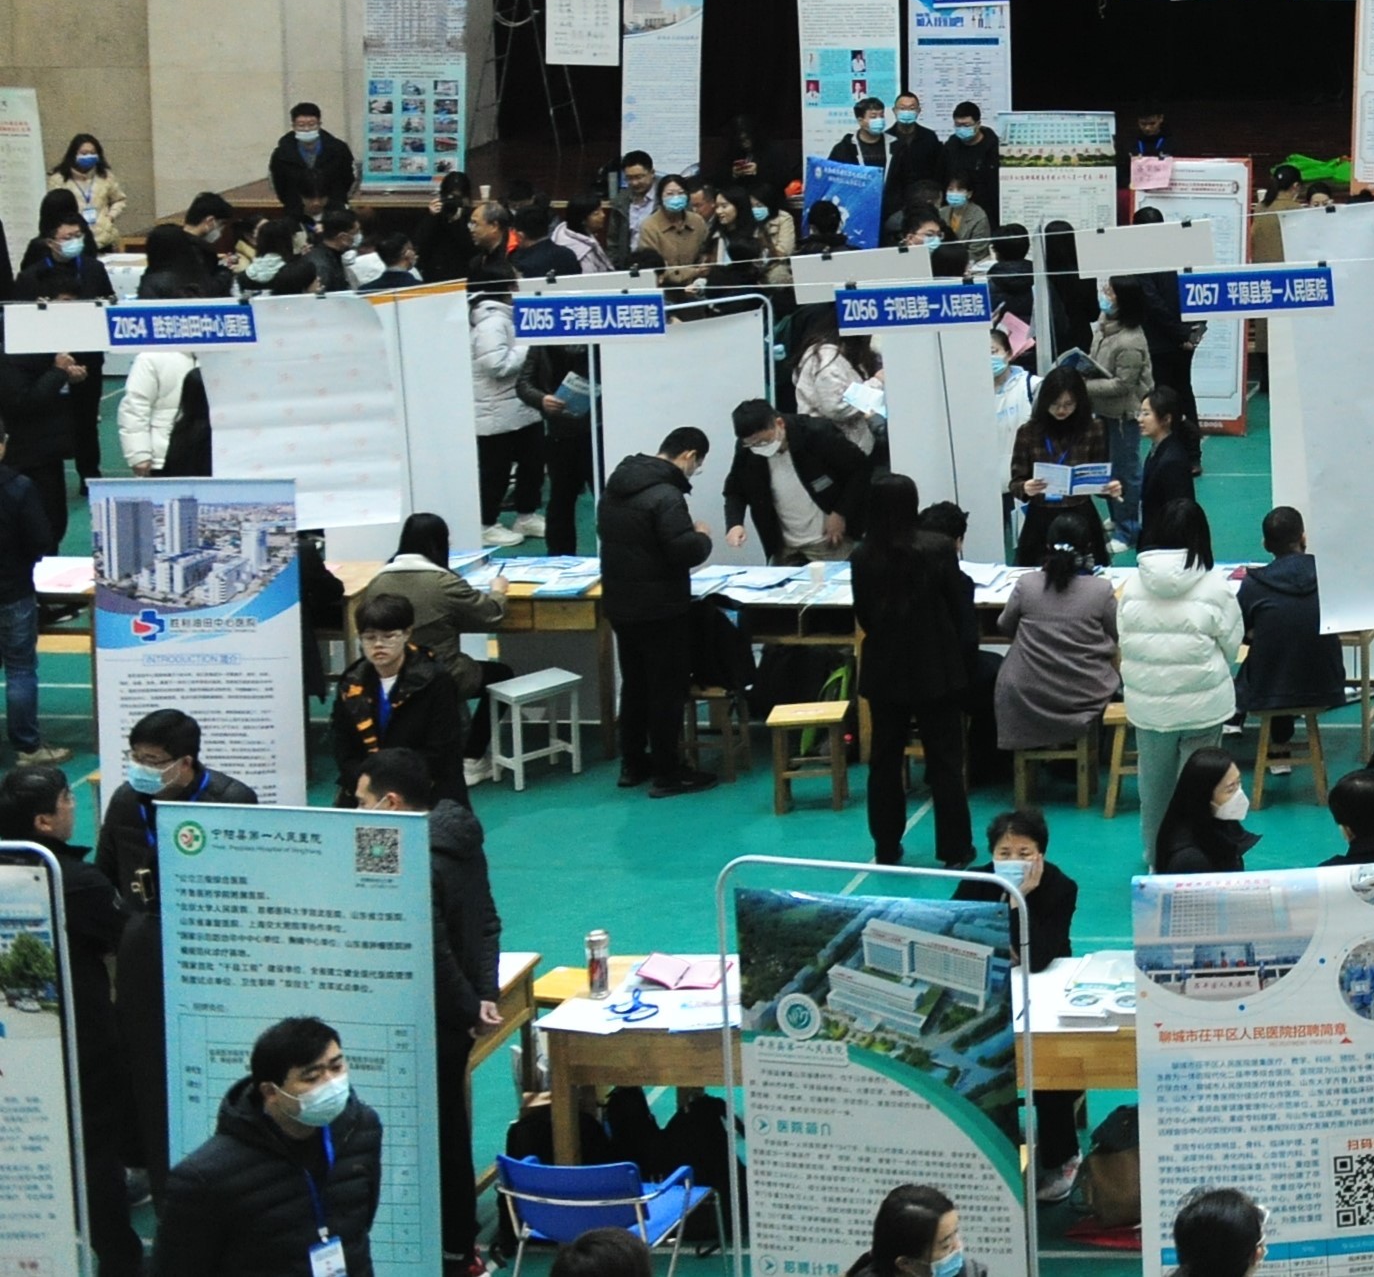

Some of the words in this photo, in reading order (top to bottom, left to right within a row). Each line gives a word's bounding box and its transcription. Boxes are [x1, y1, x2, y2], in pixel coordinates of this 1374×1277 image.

[1186, 282, 1220, 307] Z057
[1227, 278, 1329, 305] 平原县第一人民医院
[519, 306, 555, 332] Z055
[560, 303, 660, 331] 宁津县人民医院
[843, 296, 879, 322] Z056
[884, 292, 986, 320] 宁阳县第一人民医院
[112, 313, 148, 340] Z054
[153, 312, 252, 339] 胜利油田中心医院
[1159, 1022, 1347, 1044] 聊城市茌平区人民医院招聘简章
[776, 1119, 831, 1136] 医院简介
